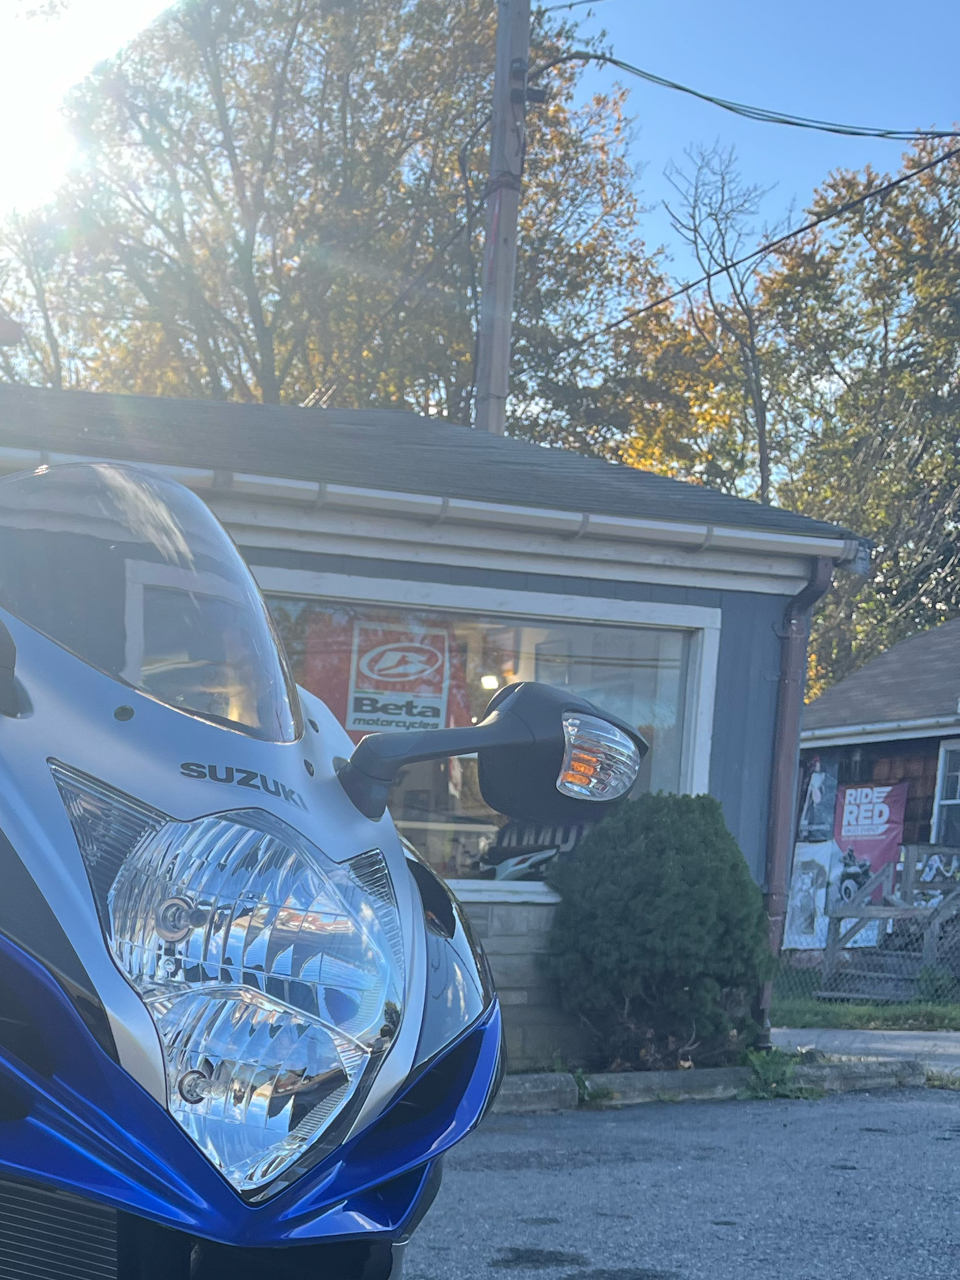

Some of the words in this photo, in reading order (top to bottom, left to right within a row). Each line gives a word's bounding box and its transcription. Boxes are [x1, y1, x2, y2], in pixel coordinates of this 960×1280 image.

[353, 697, 441, 718] Beta
[352, 717, 440, 730] motorcycles
[179, 762, 309, 812] SUZUKI
[845, 786, 893, 805] RIDE
[842, 803, 890, 827] RED
